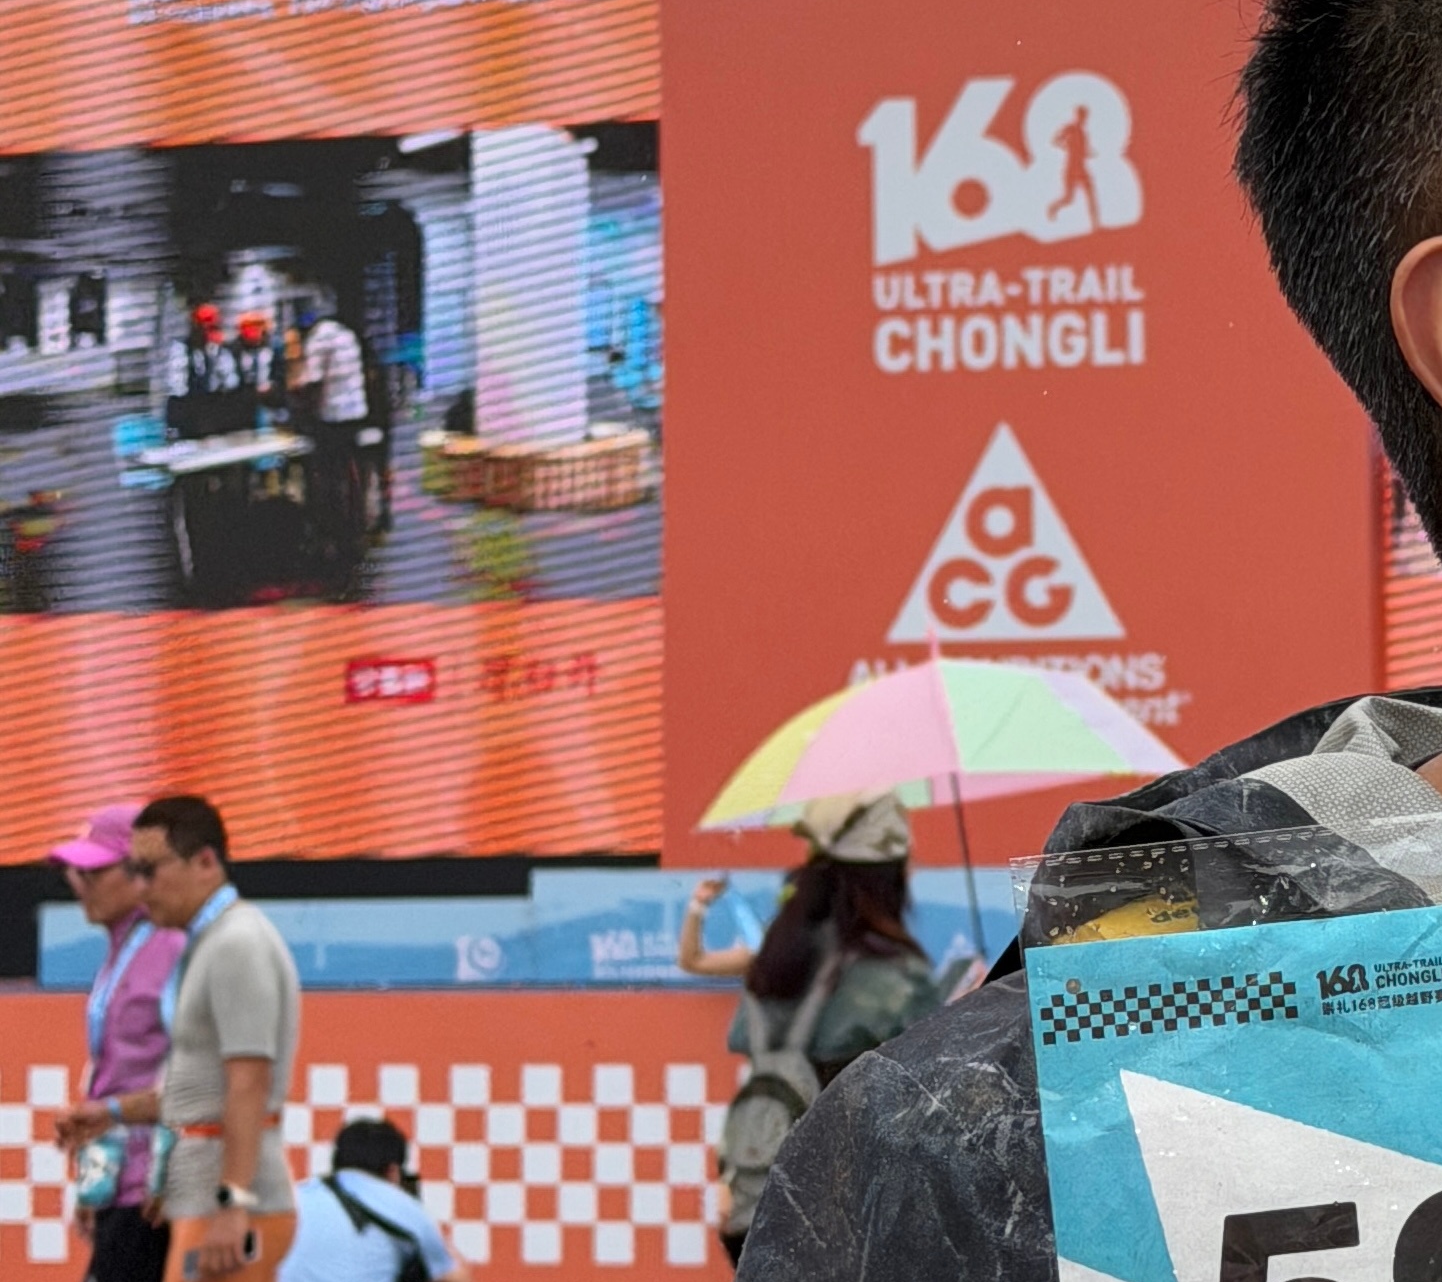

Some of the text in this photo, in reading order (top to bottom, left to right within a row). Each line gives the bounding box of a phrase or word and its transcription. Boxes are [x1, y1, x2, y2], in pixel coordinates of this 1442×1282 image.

[856, 69, 1144, 268] 168
[873, 265, 1144, 309] ULTRA-TRAIL
[874, 310, 1145, 372] CHONGLI
[1316, 963, 1369, 1000] 168
